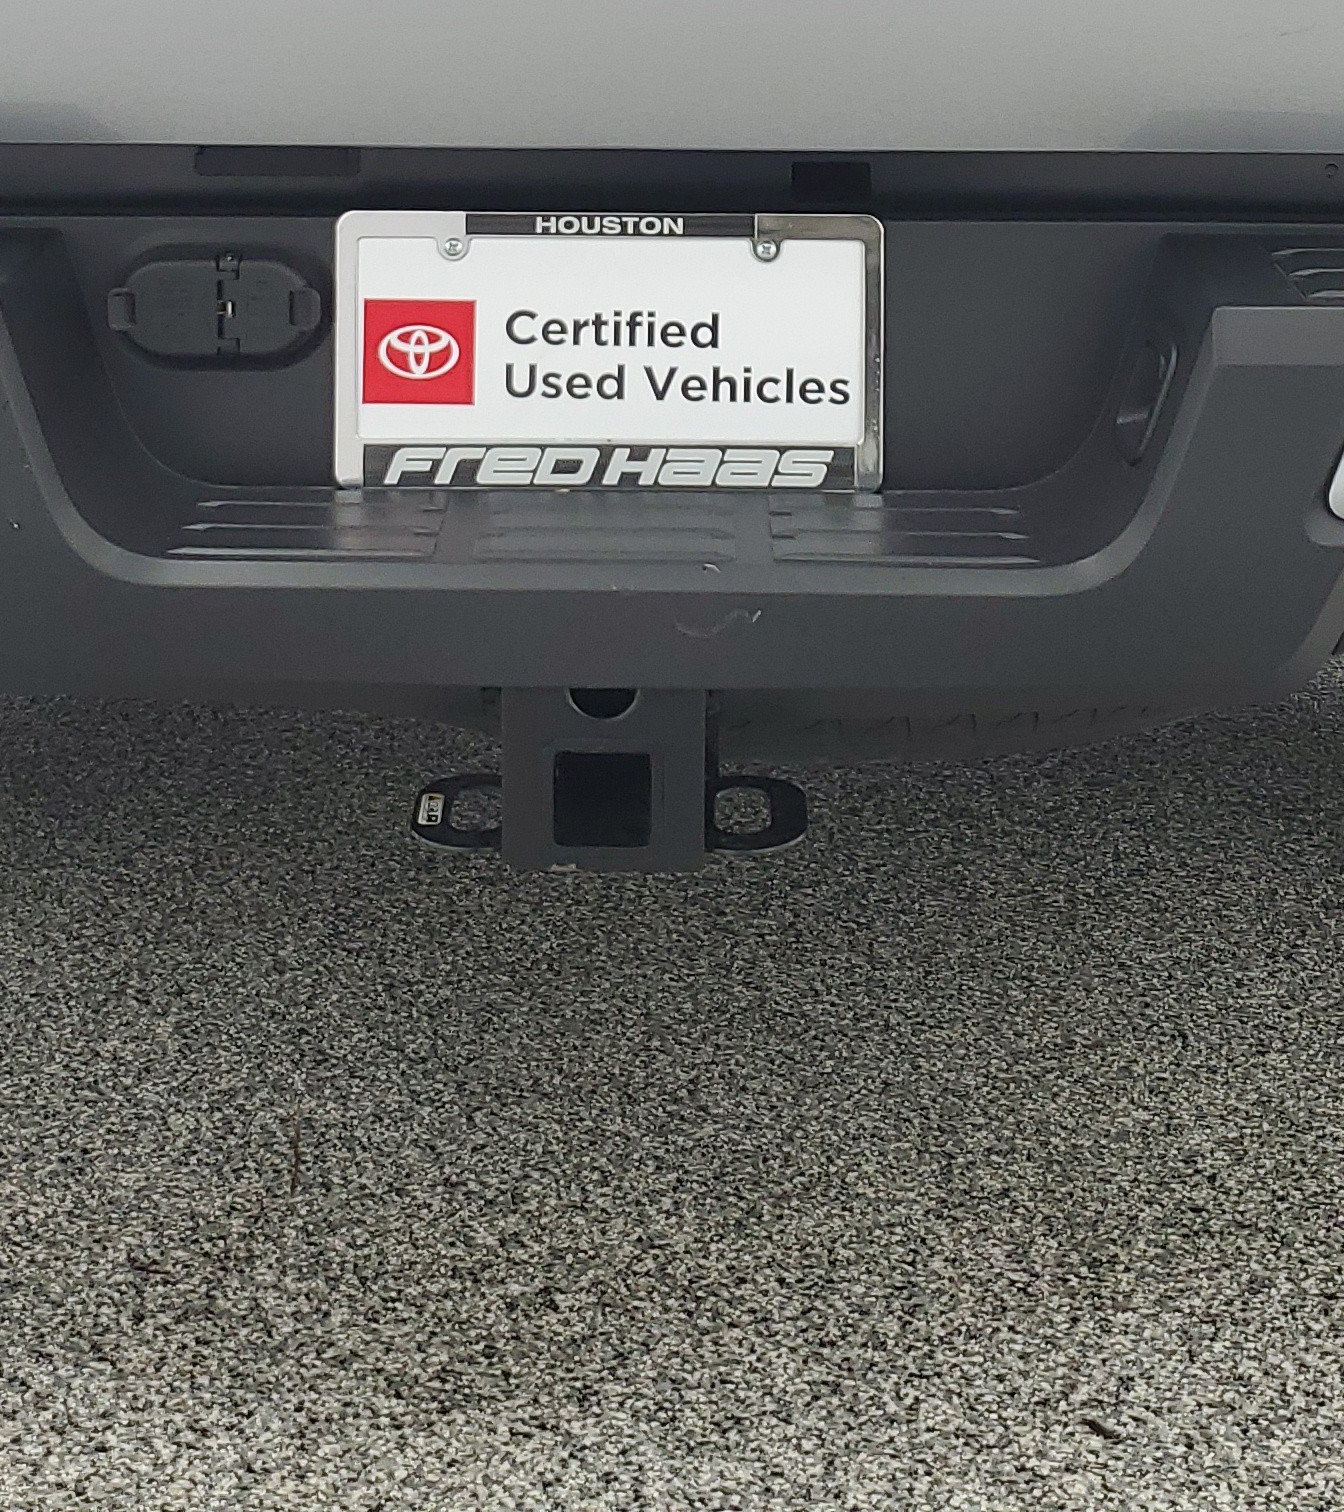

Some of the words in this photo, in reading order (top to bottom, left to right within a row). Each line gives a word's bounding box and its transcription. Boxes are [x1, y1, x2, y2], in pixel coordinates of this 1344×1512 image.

[535, 216, 684, 236] HOUSTON
[505, 309, 720, 349] Certified
[505, 363, 626, 400] Used
[643, 365, 851, 405] Vehicles
